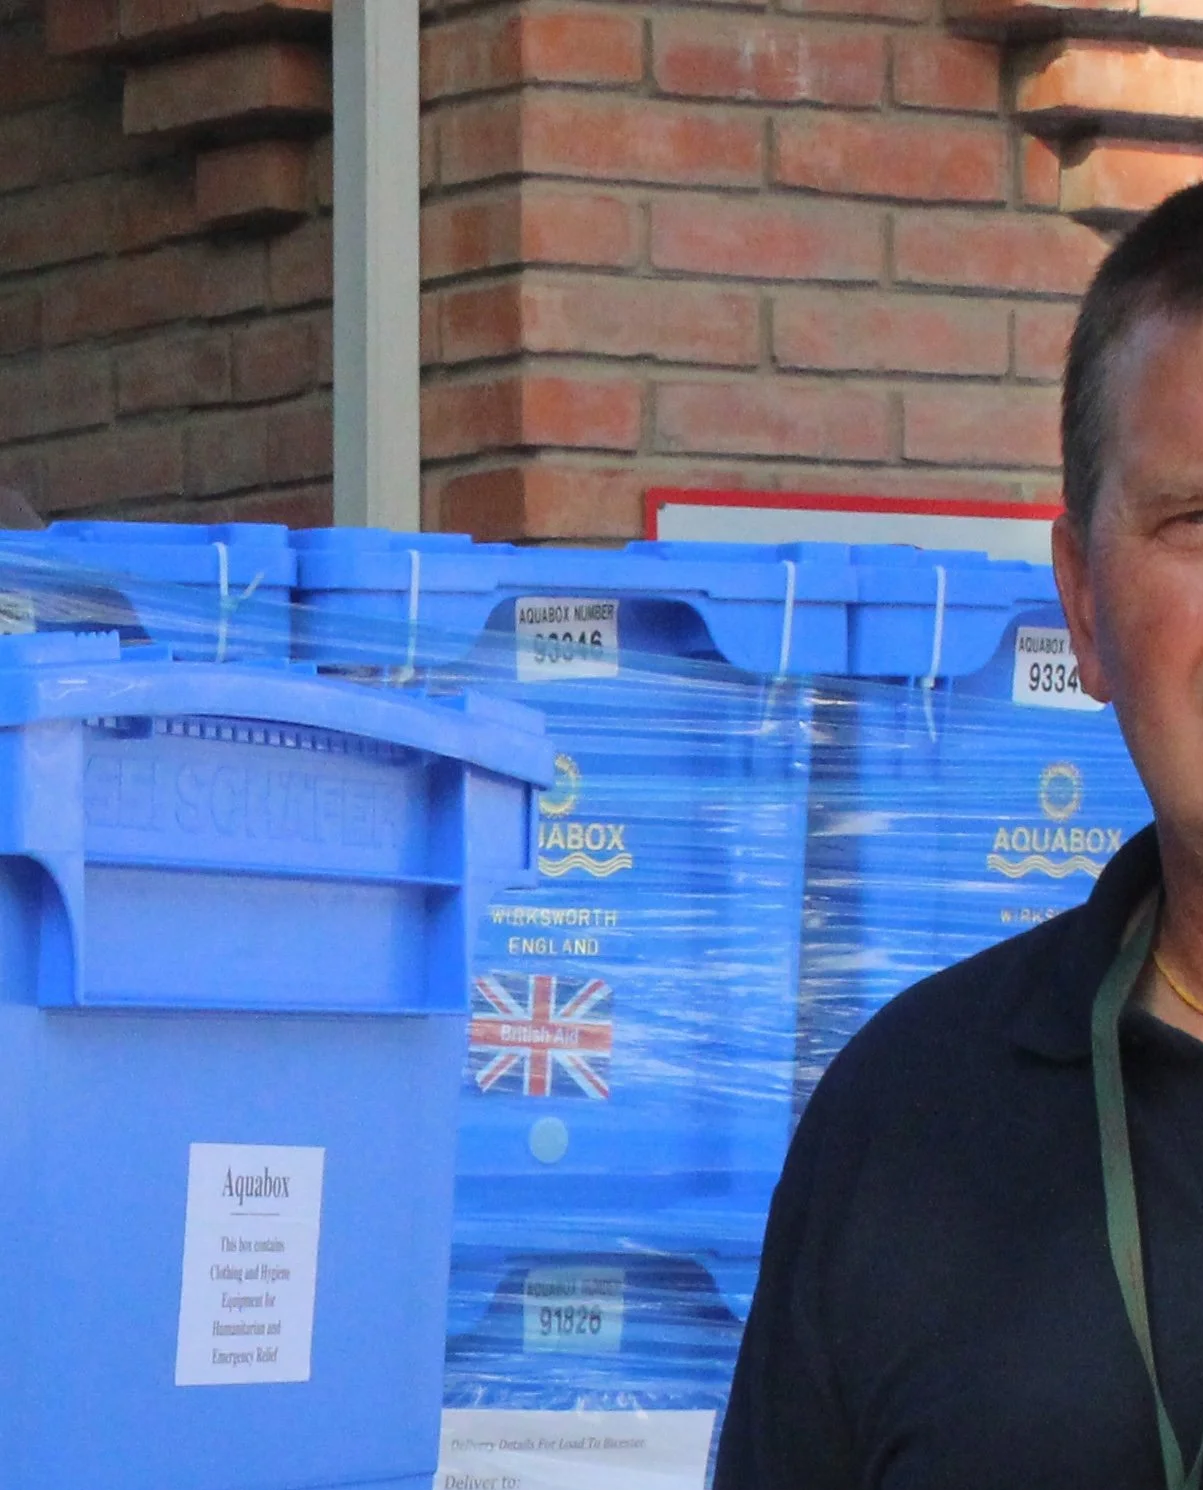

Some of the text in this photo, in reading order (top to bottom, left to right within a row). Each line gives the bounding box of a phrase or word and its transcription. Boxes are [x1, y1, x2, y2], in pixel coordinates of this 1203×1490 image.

[519, 604, 614, 624] AQUABOX NUMBER
[1018, 637, 1065, 654] AQUABOX
[1028, 662, 1079, 693] 9334
[538, 823, 625, 851] ABOX
[993, 826, 1122, 853] AQUABOX
[491, 907, 618, 928] WIRKSWORTH
[508, 937, 599, 954] ENGLAND
[500, 1023, 580, 1047] British Aid
[222, 1165, 290, 1205] Aquabox
[210, 1264, 291, 1284] Clothing and Hygiene
[221, 1292, 262, 1312] Equipment
[212, 1320, 281, 1336] Humanitarian and
[540, 1305, 602, 1336] 91826
[212, 1347, 278, 1367] Emergency Relief
[499, 1438, 535, 1450] Details
[538, 1438, 556, 1449] For
[559, 1438, 585, 1449] Load
[588, 1437, 601, 1448] To
[443, 1475, 521, 1490] Deliver to:
